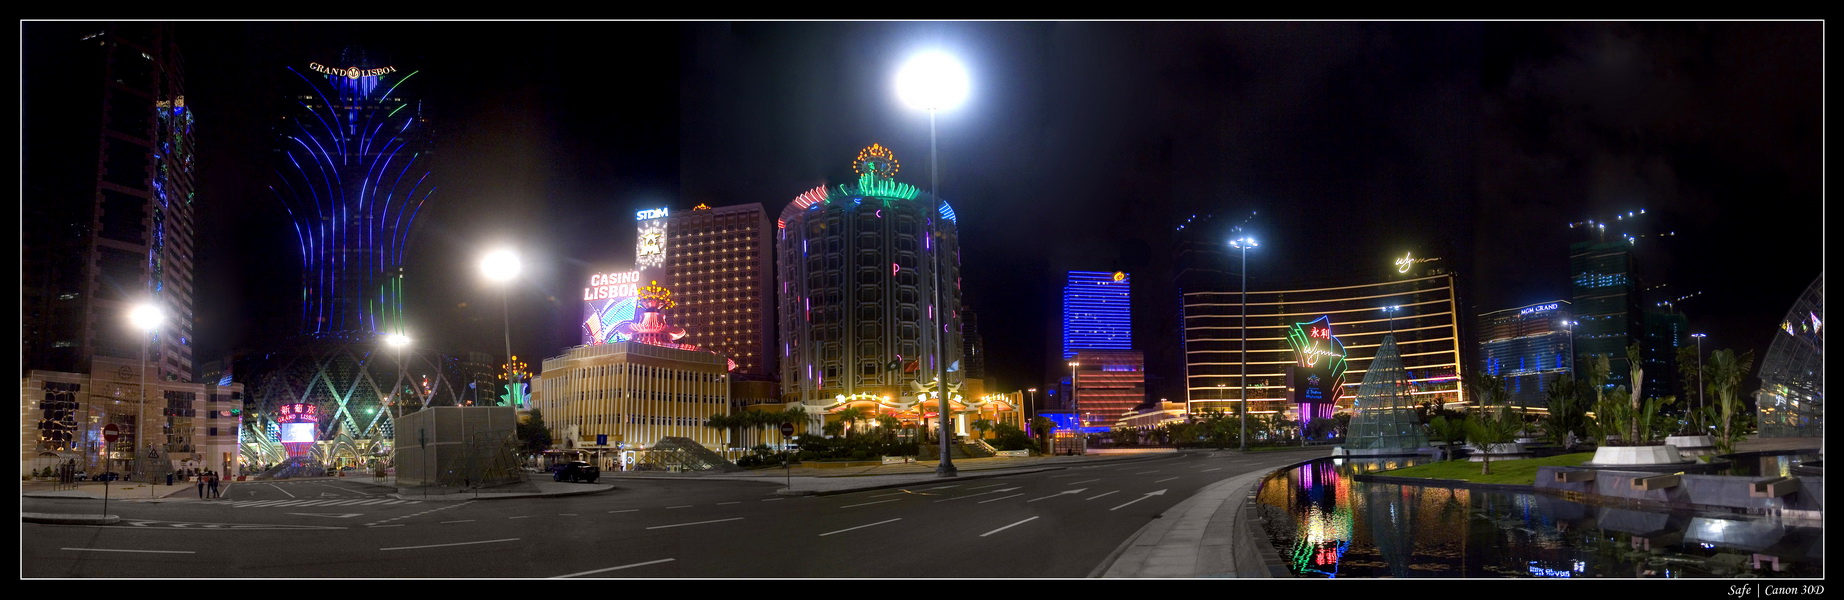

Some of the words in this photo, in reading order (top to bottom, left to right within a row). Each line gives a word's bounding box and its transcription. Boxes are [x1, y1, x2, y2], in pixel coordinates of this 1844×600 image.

[309, 62, 347, 77] GRAND
[361, 65, 397, 77] LISBOA
[636, 207, 669, 221] STDM
[590, 270, 640, 287] CASINO
[583, 283, 639, 301] LISBOA
[1535, 303, 1558, 312] GRAND
[1311, 326, 1330, 340] 永利
[281, 403, 317, 415] 新葡京
[277, 413, 297, 423] GRAND
[300, 413, 318, 422] LISBOA
